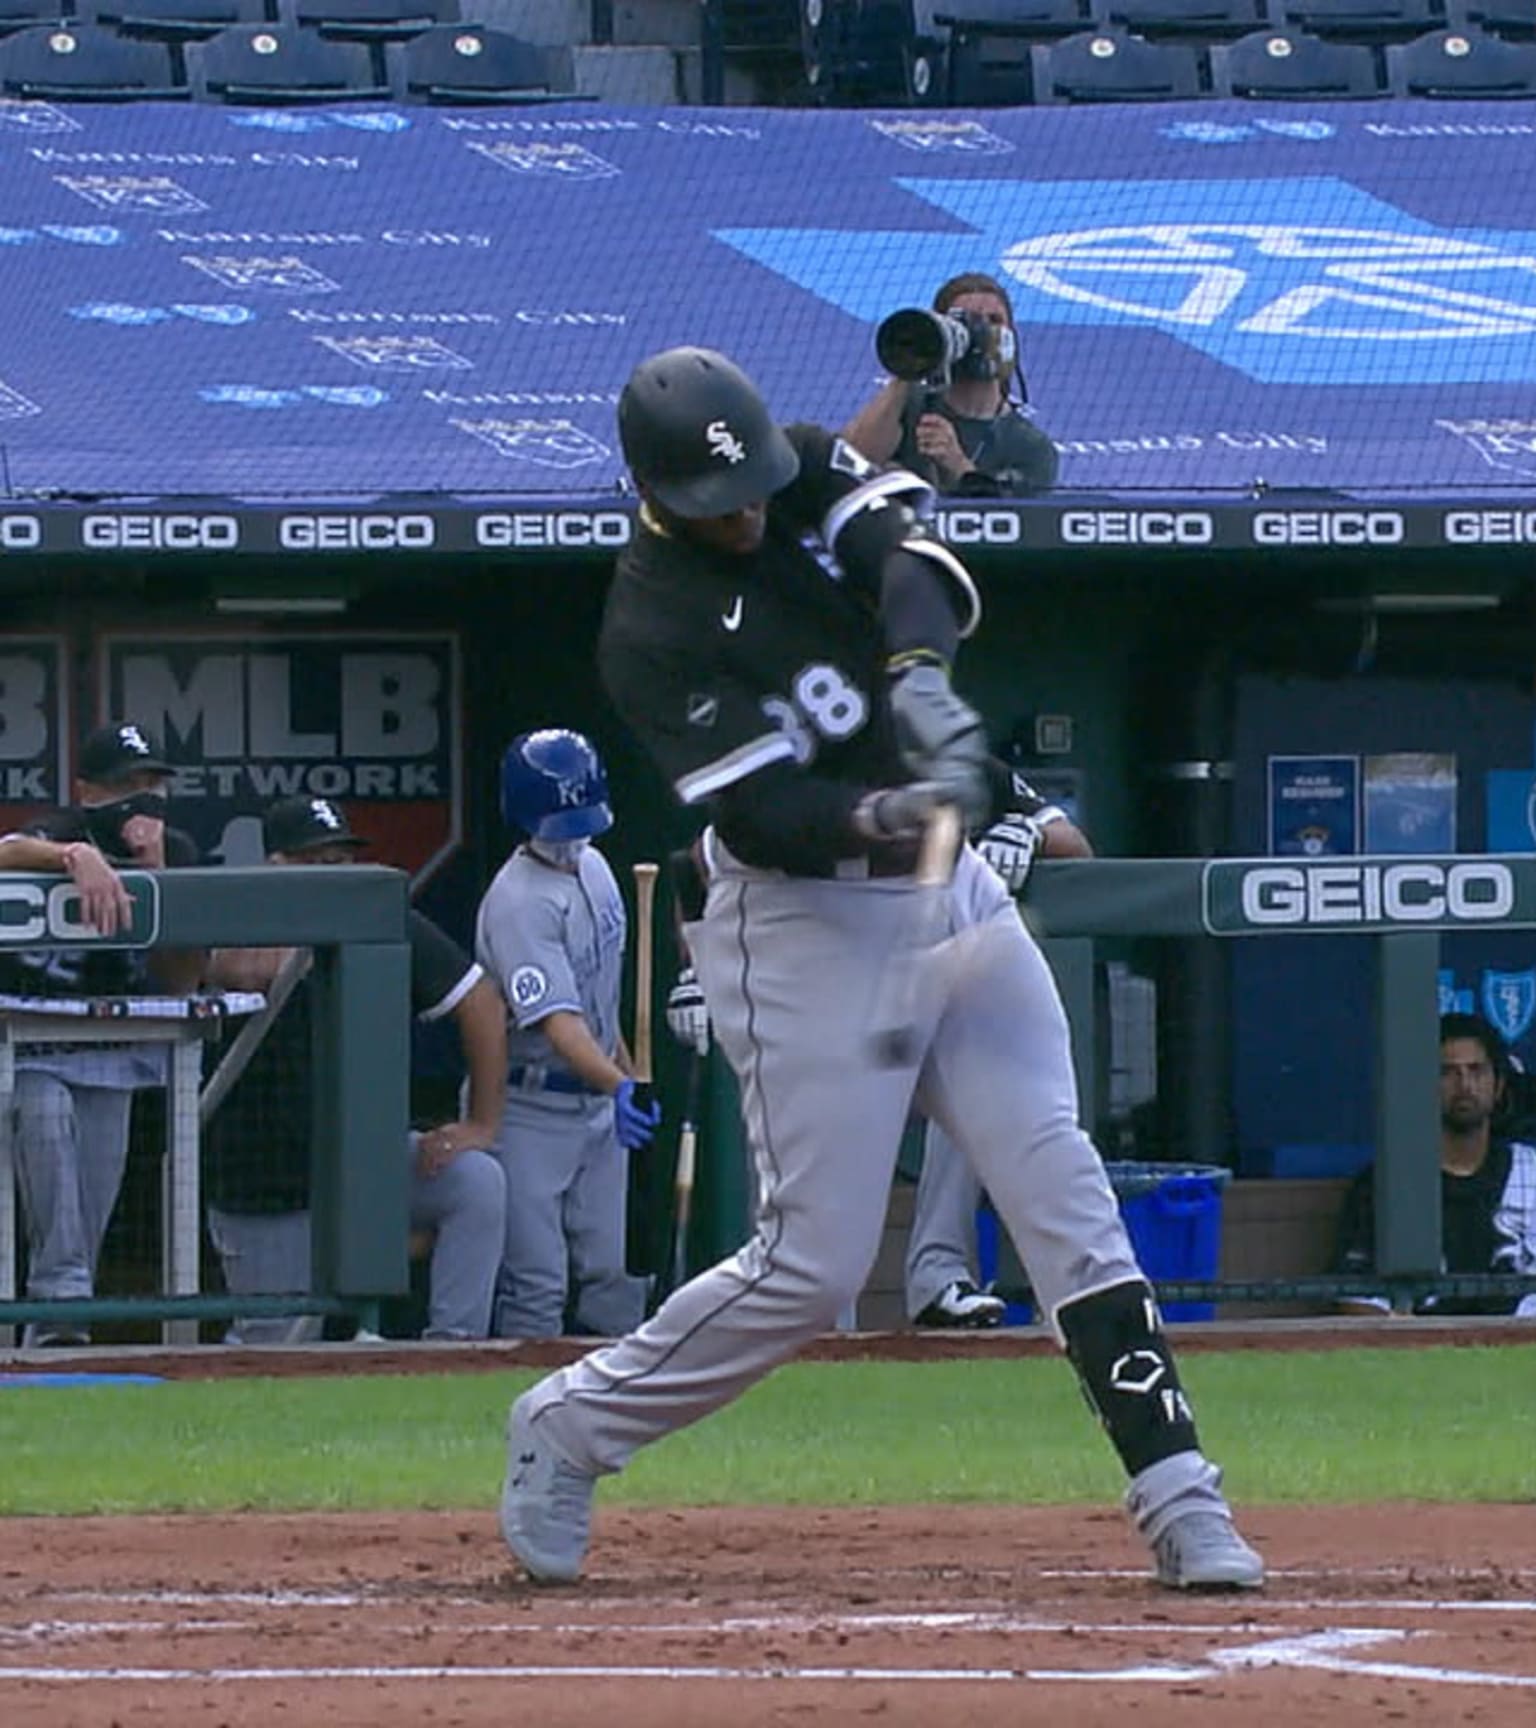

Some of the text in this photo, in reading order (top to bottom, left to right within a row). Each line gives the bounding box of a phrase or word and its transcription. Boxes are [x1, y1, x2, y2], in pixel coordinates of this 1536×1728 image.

[82, 515, 239, 548] GEICO
[279, 515, 436, 548] GEICO
[475, 513, 631, 546] GEICO
[931, 511, 1021, 543] ICO
[1061, 511, 1213, 543] GEICO
[1252, 510, 1405, 543] GEICO
[121, 652, 441, 760] MLB
[166, 764, 441, 796] ETWORK
[1242, 862, 1515, 924] GEICO
